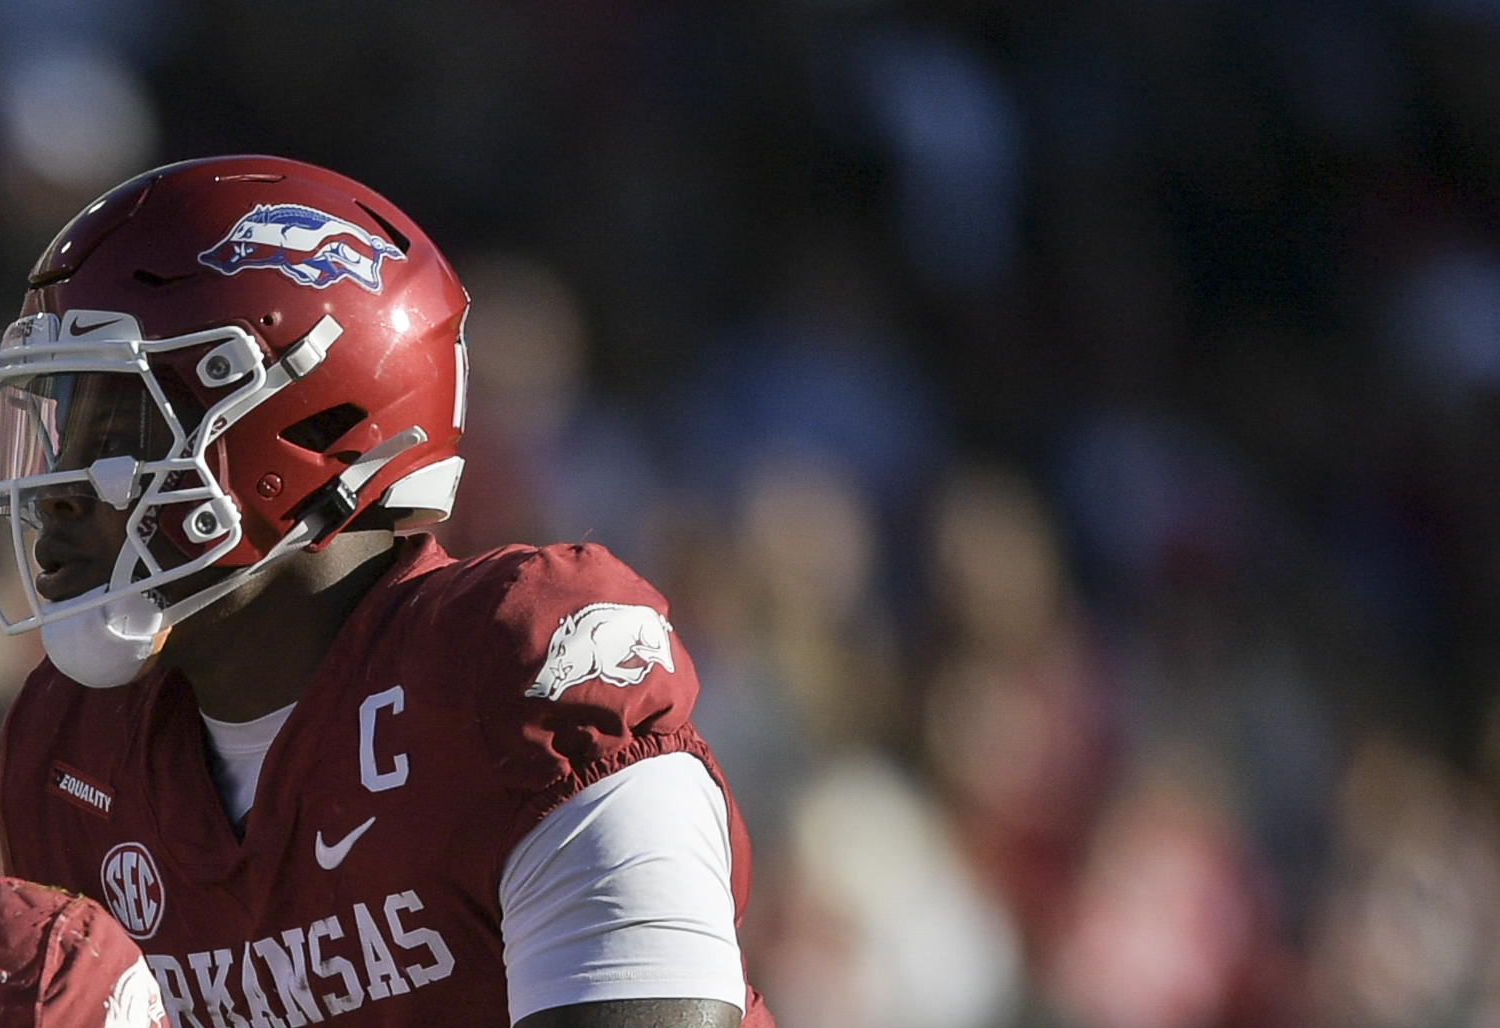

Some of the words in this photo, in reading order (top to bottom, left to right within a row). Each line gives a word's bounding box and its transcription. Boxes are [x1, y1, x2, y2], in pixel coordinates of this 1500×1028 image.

[359, 685, 409, 793] C
[59, 773, 112, 813] EQUALITY
[106, 851, 158, 932] SEC
